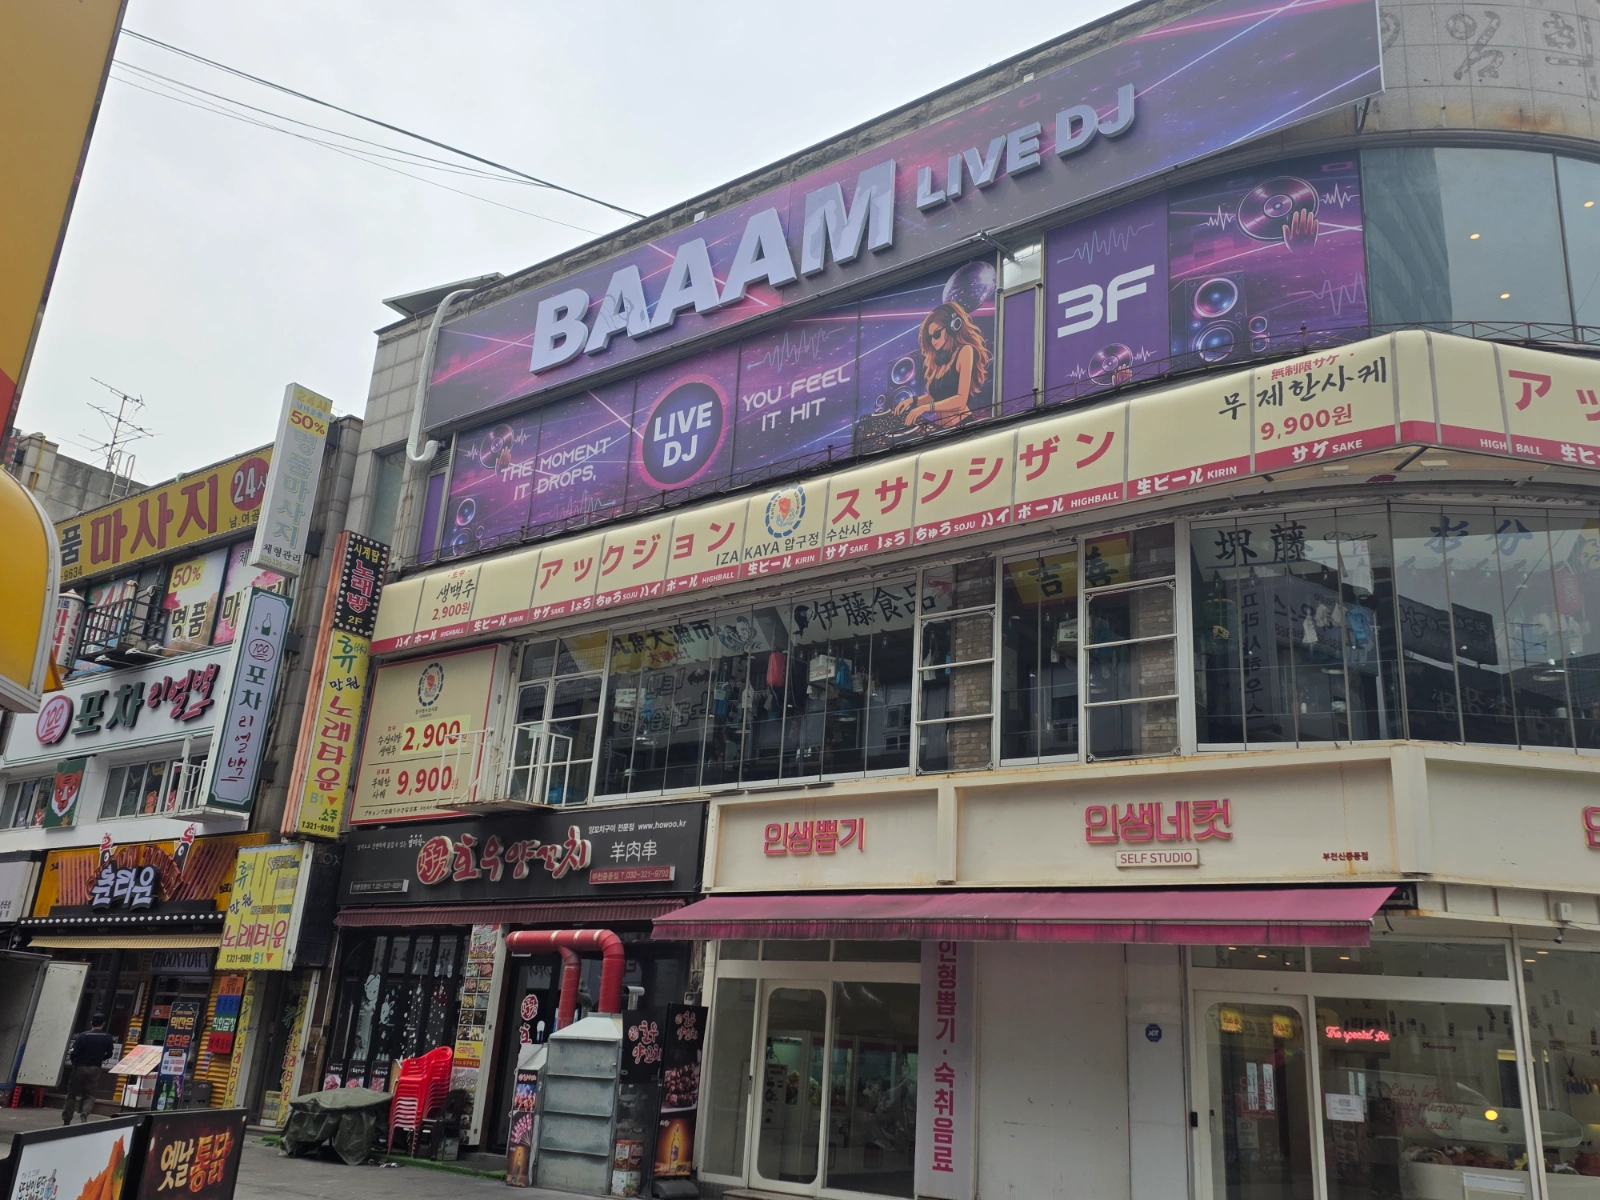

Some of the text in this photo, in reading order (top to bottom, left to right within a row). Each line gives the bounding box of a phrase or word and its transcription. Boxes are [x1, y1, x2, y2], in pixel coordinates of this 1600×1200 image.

[529, 83, 1135, 375] BAAAM LIVE DJ
[1057, 264, 1155, 338] 3F
[1270, 353, 1340, 382] 無制限サケ
[743, 365, 851, 411] YOU FEEL
[290, 410, 326, 435] 50%
[652, 401, 713, 442] LIVE
[761, 398, 826, 432] IT HIT
[1260, 403, 1354, 442] 9,900원
[500, 437, 611, 484] THE MOMENT
[662, 435, 698, 468] DJ
[273, 429, 318, 549] 명품마사지
[513, 465, 597, 501] IT DROPS,
[1071, 490, 1119, 508] HIGHBALL
[1137, 467, 1204, 496] 生ビール
[1207, 465, 1238, 480] KIRIN
[1291, 442, 1328, 463] サケ
[1332, 438, 1363, 454] SAKE
[90, 474, 219, 565] 마사지
[784, 532, 820, 552] 압구정
[826, 519, 874, 543] 수산시장
[263, 542, 302, 565] 체형관리
[354, 543, 381, 564] 시계탑
[539, 521, 736, 590] アックジョン
[701, 571, 735, 585] HIGHBALL
[747, 554, 793, 576] 生ビール
[795, 553, 815, 565] KIRIN
[825, 543, 847, 560] サケ
[849, 542, 869, 554] SAKE
[953, 521, 976, 532] SOJU
[172, 564, 202, 589] 50%
[347, 559, 375, 614] 노래방
[436, 579, 476, 603] 생맥주
[171, 601, 209, 639] 명품
[347, 615, 363, 626] 2F
[431, 601, 471, 621] 2,900원
[440, 628, 465, 639] HIGHBALL
[473, 614, 507, 633] 生ビール
[508, 614, 525, 625] KIRIN
[532, 605, 551, 620] サケ
[550, 605, 565, 617] SAKE
[622, 590, 639, 601] SOJU
[811, 582, 937, 631] 伊藤食品
[238, 665, 268, 711] 포차
[71, 681, 146, 735] 포차
[313, 695, 354, 792] 노래타운
[378, 720, 461, 751] 수산시장 2,900
[378, 745, 397, 757] 생맥주
[371, 765, 453, 796] 무제한 9,900
[372, 790, 386, 800] 사케
[309, 792, 325, 805] B1
[617, 822, 635, 833] 전문점
[638, 819, 687, 832] www.howoo.kr
[763, 817, 866, 857] 인생뽑기
[1084, 797, 1234, 844] 인생네컷
[453, 826, 590, 882] 호우양꼬치
[610, 839, 658, 863] 羊肉串
[1120, 851, 1194, 865] SELF STUDIO
[91, 863, 155, 906] 춘타운
[620, 867, 670, 880] T.032-321-9792
[222, 920, 288, 949] 노래타운
[253, 952, 264, 964] B1
[166, 1033, 191, 1048] 춘타운
[212, 1016, 237, 1032] 직화곱창
[1147, 1029, 1160, 1037] ADT
[1325, 1026, 1343, 1040] The
[1343, 1028, 1375, 1043] special
[228, 1037, 243, 1097] 노래타운
[1390, 1082, 1419, 1098] Each
[932, 1061, 955, 1174] 숙취음료
